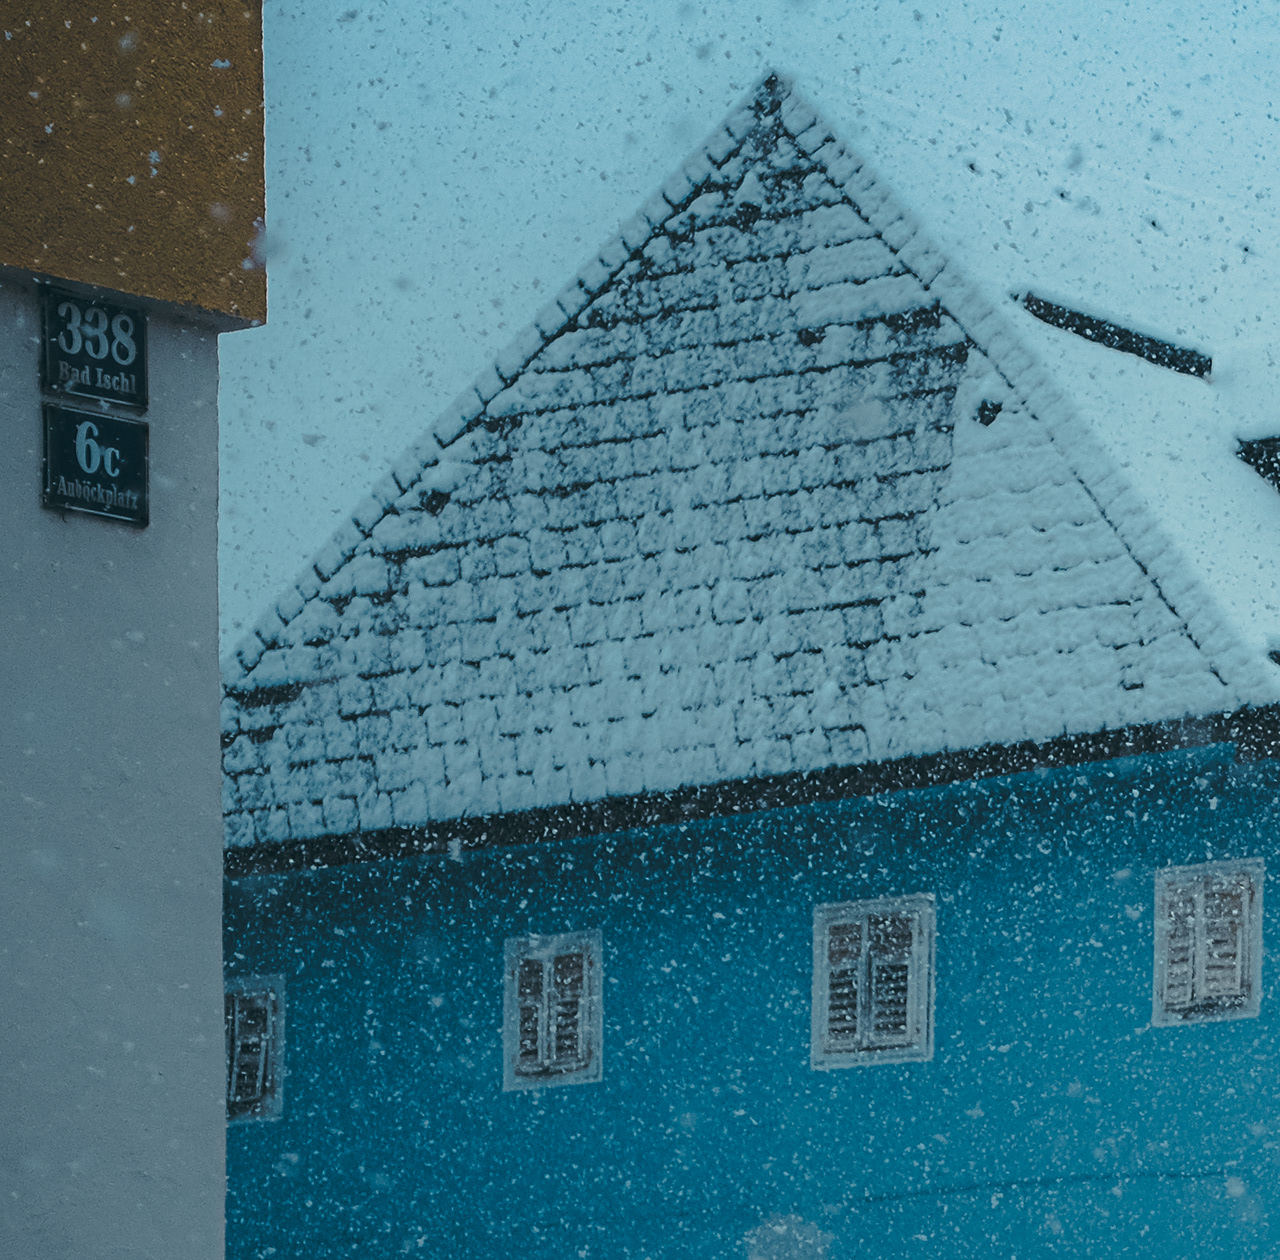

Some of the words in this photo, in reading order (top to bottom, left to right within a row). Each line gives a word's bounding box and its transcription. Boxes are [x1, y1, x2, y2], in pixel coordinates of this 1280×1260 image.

[58, 302, 136, 366] 338
[59, 360, 91, 386] Bad
[95, 368, 137, 395] Ischl
[76, 421, 120, 477] 6c
[57, 475, 138, 510] Auböckplatz
